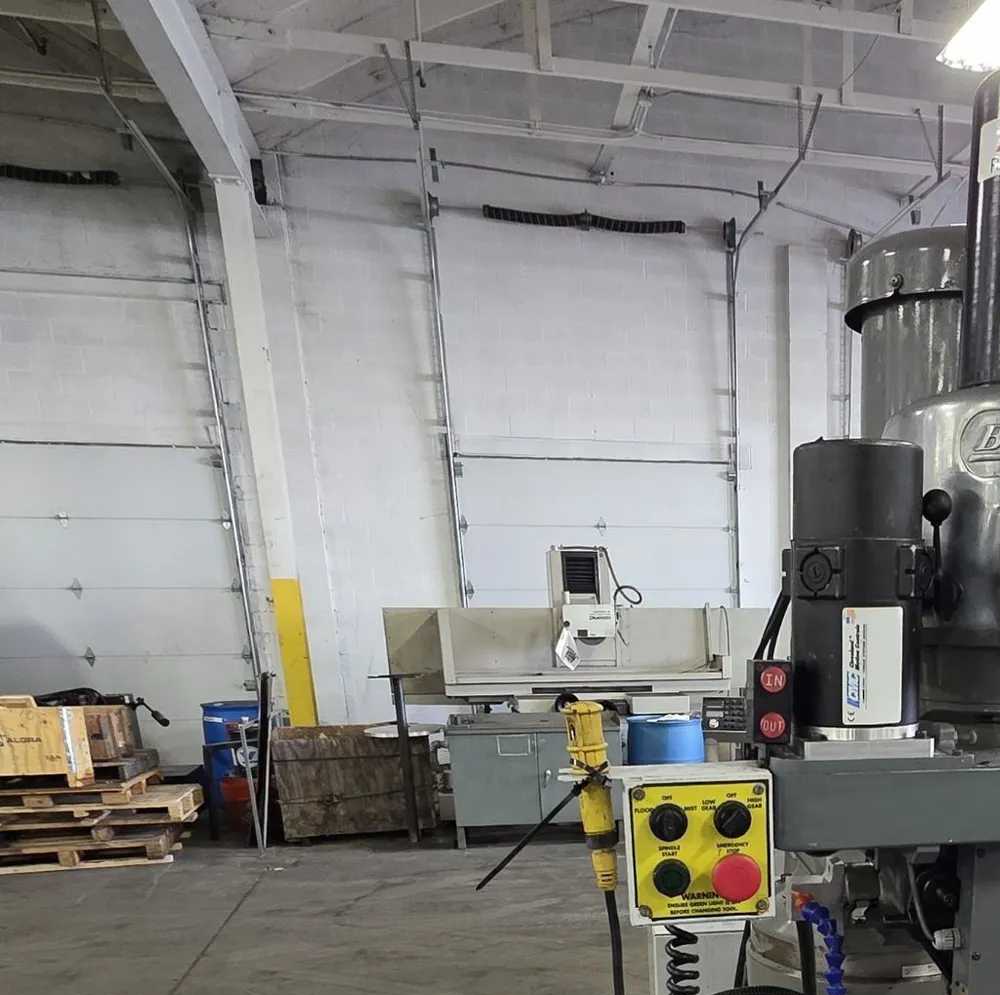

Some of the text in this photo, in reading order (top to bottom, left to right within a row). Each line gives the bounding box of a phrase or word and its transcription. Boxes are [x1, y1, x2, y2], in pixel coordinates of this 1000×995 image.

[765, 673, 784, 687] IN
[762, 721, 784, 732] OUT
[682, 891, 721, 900] WARNIN
